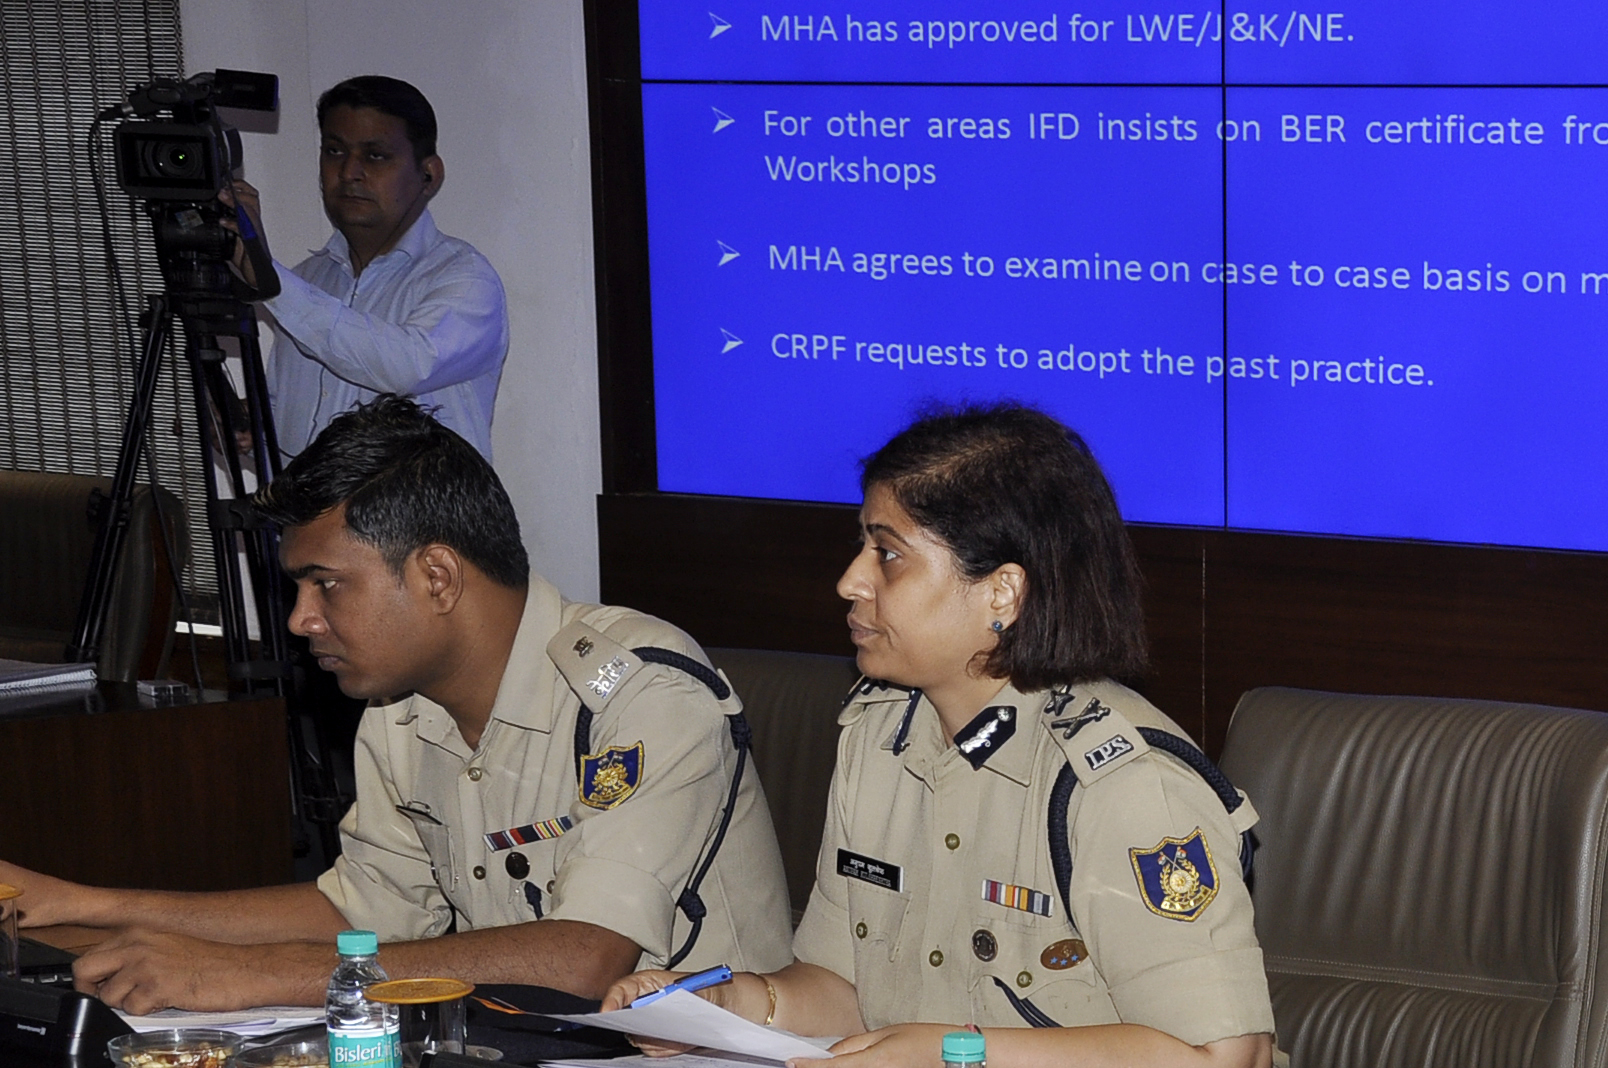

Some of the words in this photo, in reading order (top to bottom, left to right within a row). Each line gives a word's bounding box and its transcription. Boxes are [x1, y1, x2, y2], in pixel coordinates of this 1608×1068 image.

[761, 14, 839, 42] MHA
[846, 13, 899, 42] has
[908, 13, 1058, 49] approved
[1068, 13, 1115, 42] for
[1126, 10, 1354, 48] LWE/J&K/NE.
[764, 110, 812, 137] For
[826, 109, 911, 138] other
[927, 117, 1011, 140] areas
[1029, 112, 1080, 140] IFD
[1098, 111, 1198, 142] insists
[1215, 119, 1261, 142] on
[1281, 114, 1347, 143] BER
[1365, 114, 1545, 145] certificate
[764, 155, 937, 191] Workshops
[769, 244, 846, 273] MHA
[852, 252, 954, 281] agrees
[961, 251, 995, 277] to
[1004, 252, 1143, 282] examine
[1149, 261, 1190, 283] on
[1201, 262, 1279, 286] case
[1288, 260, 1325, 287] to
[1334, 266, 1411, 290] case
[1423, 260, 1511, 292] basis
[1521, 271, 1567, 294] on
[771, 333, 847, 361] CRPF
[855, 341, 987, 371] requests
[995, 343, 1029, 369] to
[1037, 343, 1132, 379] adopt
[1140, 346, 1195, 376] the
[1206, 354, 1280, 384] past
[1290, 355, 1434, 388] practice.
[334, 1042, 382, 1062] Bisleri
